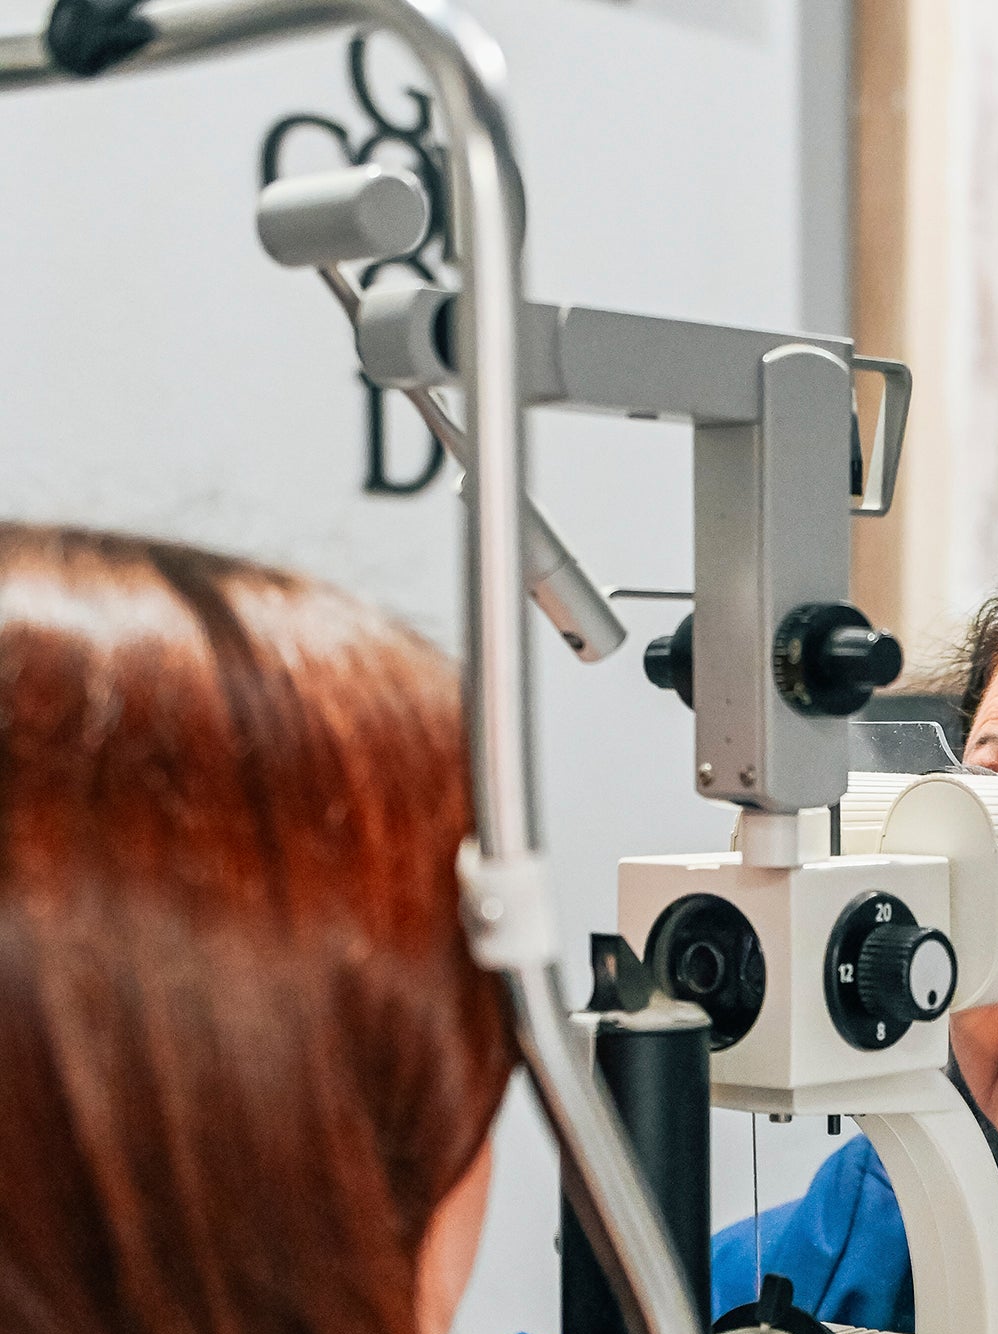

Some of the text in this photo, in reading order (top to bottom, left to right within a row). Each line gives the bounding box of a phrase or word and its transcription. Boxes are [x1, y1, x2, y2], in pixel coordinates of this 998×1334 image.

[875, 903, 892, 922] 20
[838, 963, 854, 983] 12
[876, 1021, 886, 1041] 8
